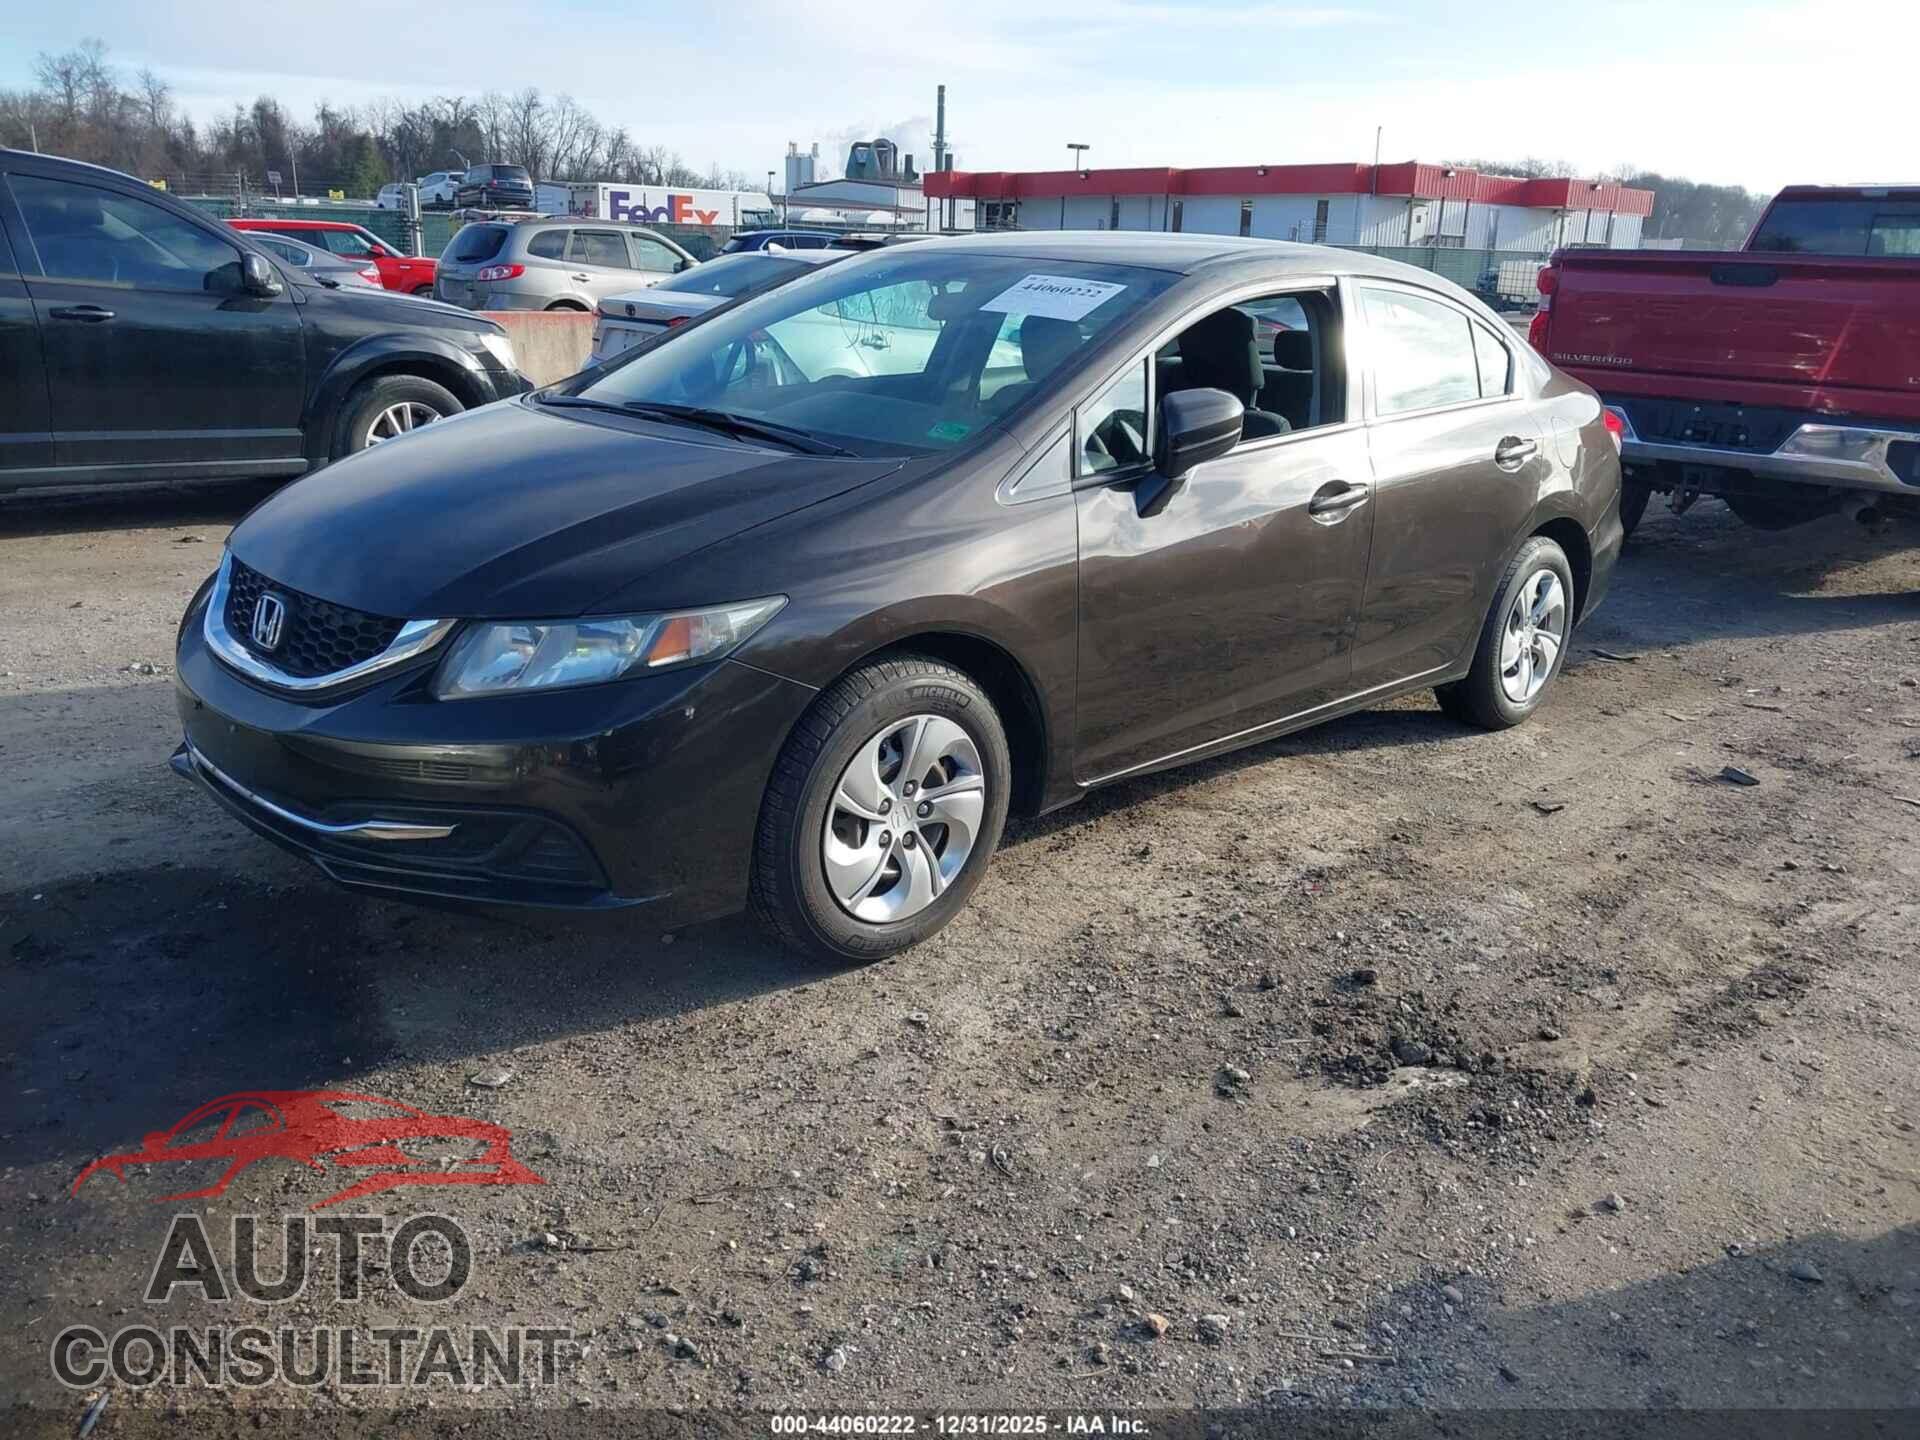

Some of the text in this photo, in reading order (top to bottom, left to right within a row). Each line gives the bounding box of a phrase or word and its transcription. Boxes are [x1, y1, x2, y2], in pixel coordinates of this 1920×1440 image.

[609, 191, 720, 225] FedEx
[1552, 352, 1632, 365] SILVERADO
[911, 686, 970, 707] MICHELIN
